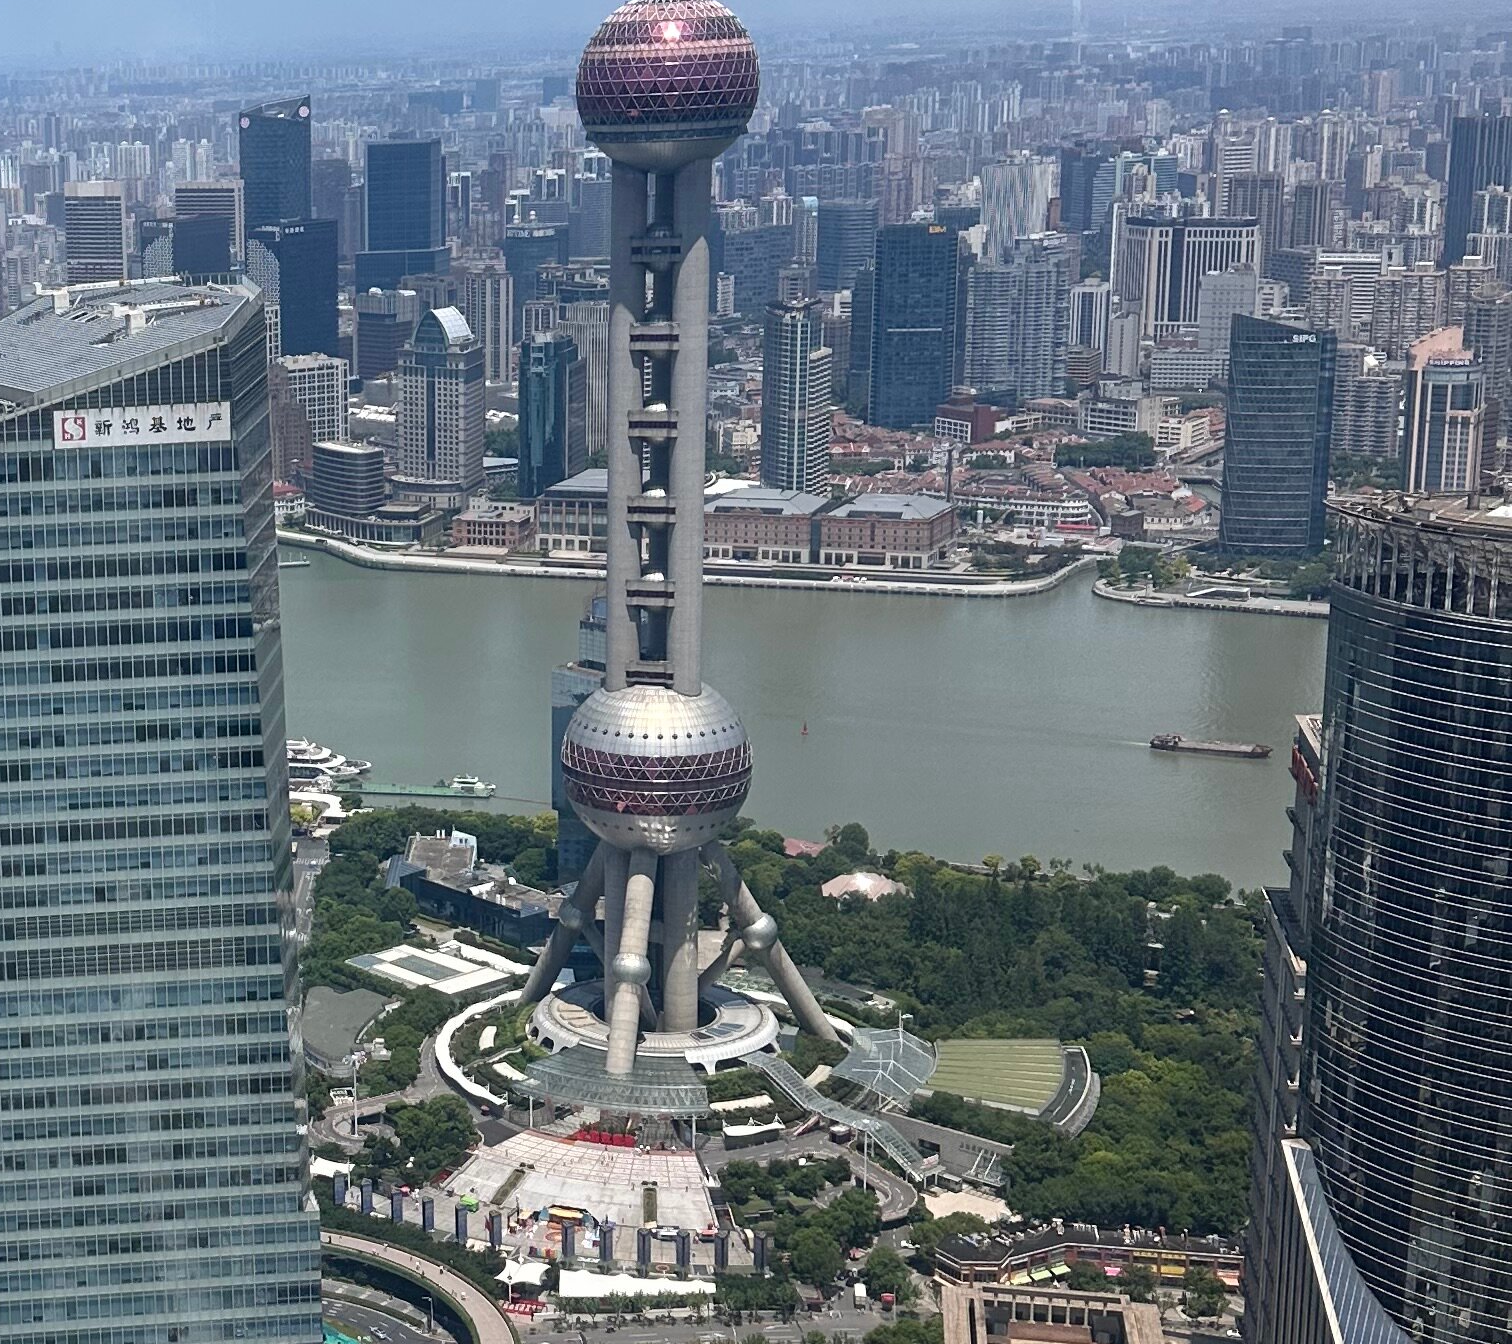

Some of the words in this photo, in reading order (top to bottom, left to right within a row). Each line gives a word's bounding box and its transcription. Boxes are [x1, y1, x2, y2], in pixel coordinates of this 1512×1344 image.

[94, 413, 223, 436] 新鸿基地产
